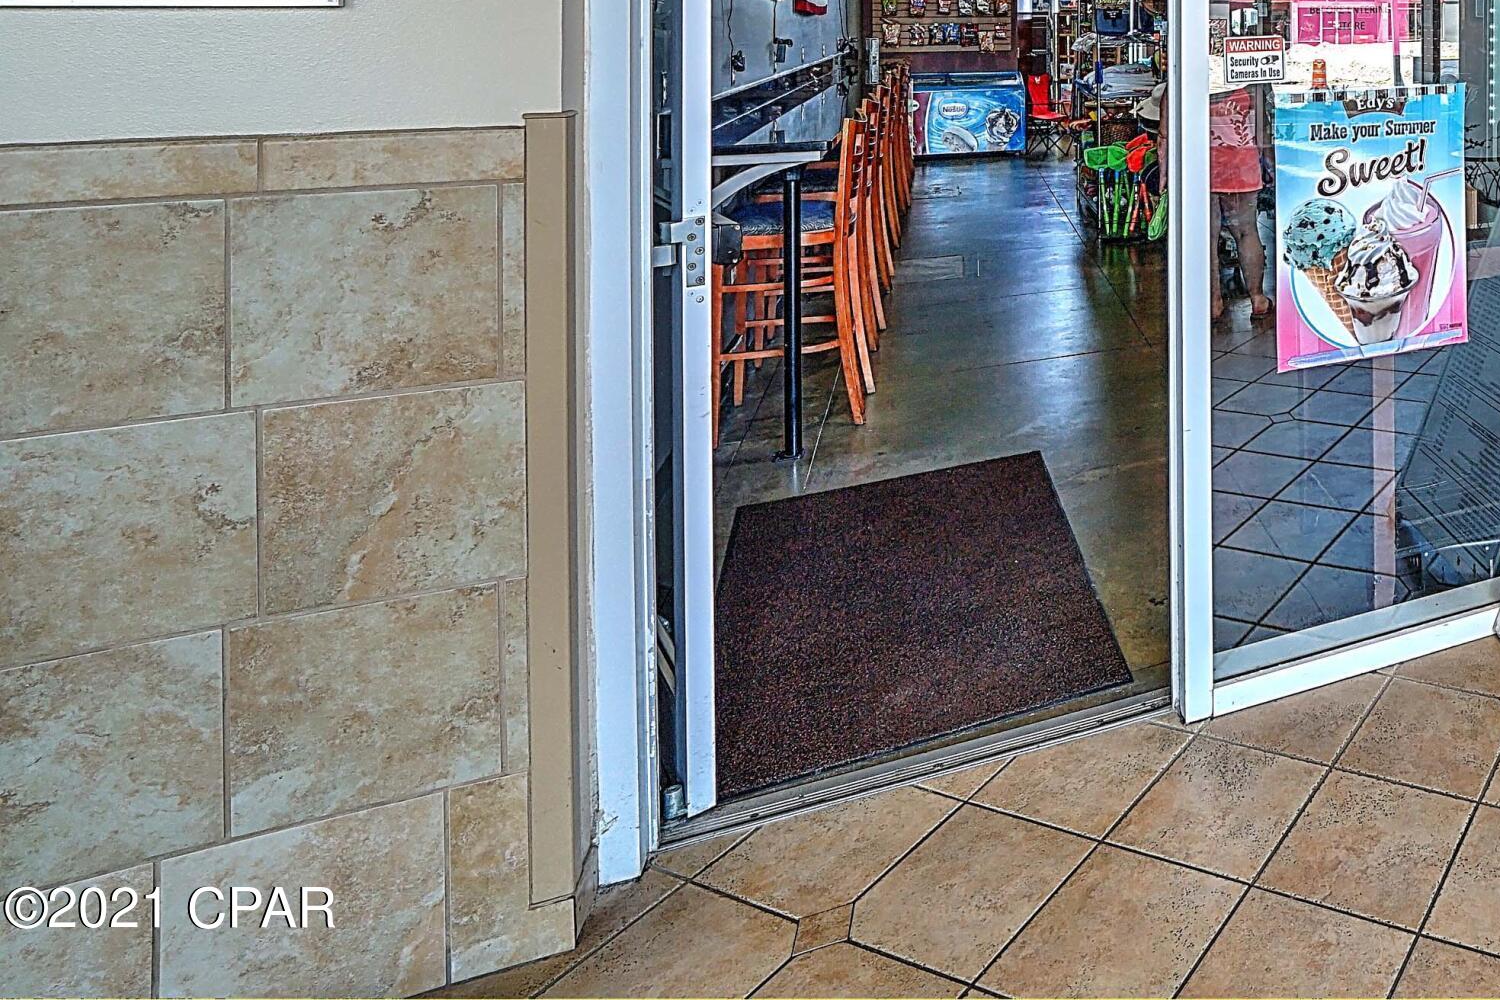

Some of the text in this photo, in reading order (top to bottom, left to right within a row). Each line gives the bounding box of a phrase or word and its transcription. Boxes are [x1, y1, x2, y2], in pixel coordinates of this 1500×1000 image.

[1229, 40, 1280, 51] WARNING
[1230, 56, 1258, 68] Security
[1231, 67, 1280, 79] Cameras In Use
[1356, 96, 1396, 111] Edy's
[1310, 120, 1435, 143] Make your Summer
[1317, 139, 1426, 198] Sweet!
